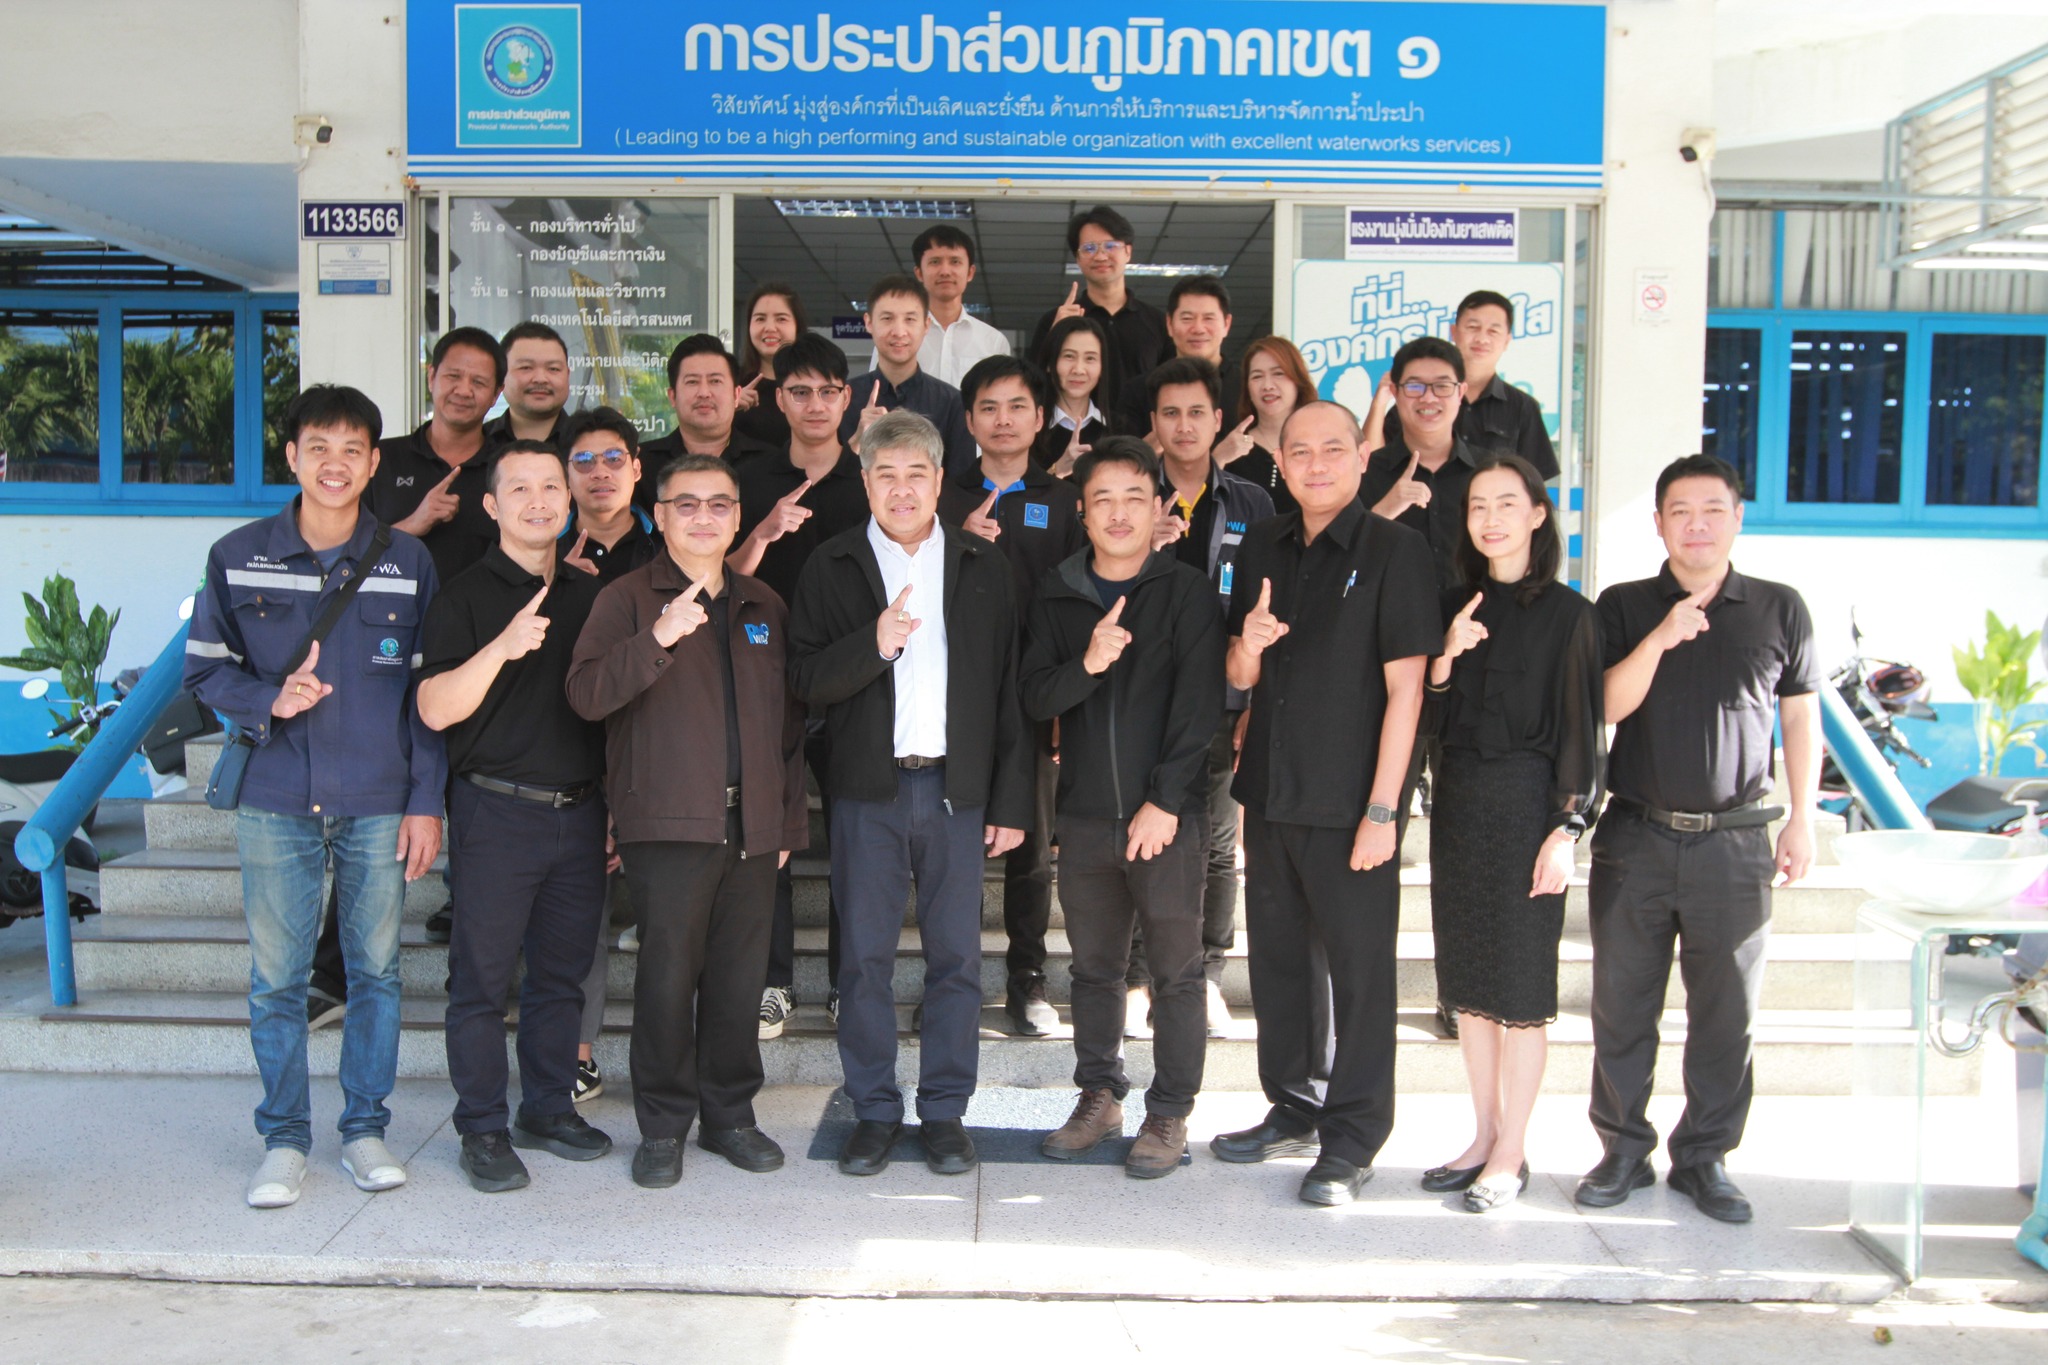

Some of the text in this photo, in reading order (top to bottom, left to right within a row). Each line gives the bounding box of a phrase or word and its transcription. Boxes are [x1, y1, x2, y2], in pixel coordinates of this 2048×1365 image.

[684, 12, 1440, 92] การประปาส่วนภูมิภาคเขต ๑
[711, 87, 1425, 123] วิสัยทัศน์ มุ่งสู่องค์กรที่เป็นเลิศและยั่งยืน ด้านการให้บริการและบริหารจัดการน้ำประปา
[704, 128, 721, 144] to
[727, 128, 750, 145] be
[756, 130, 767, 145] a
[773, 128, 812, 149] high
[818, 128, 917, 150] performing
[922, 129, 958, 146] and
[963, 130, 1067, 147] sustainable
[1072, 131, 1185, 151] organization
[1189, 132, 1226, 149] with
[1231, 133, 1312, 150] excellent
[1317, 135, 1421, 152] waterworks
[308, 207, 399, 233] 1133566
[470, 211, 491, 233] ชั้น
[529, 212, 636, 233] กองบริหารทั่วไป
[529, 246, 666, 265] กองบัญชีและการเงิน
[470, 276, 492, 297] ชั้น
[530, 281, 666, 298] กองแผนและวิชาการ
[530, 308, 693, 327] กองเทคโนโลยีสารสนเทศ
